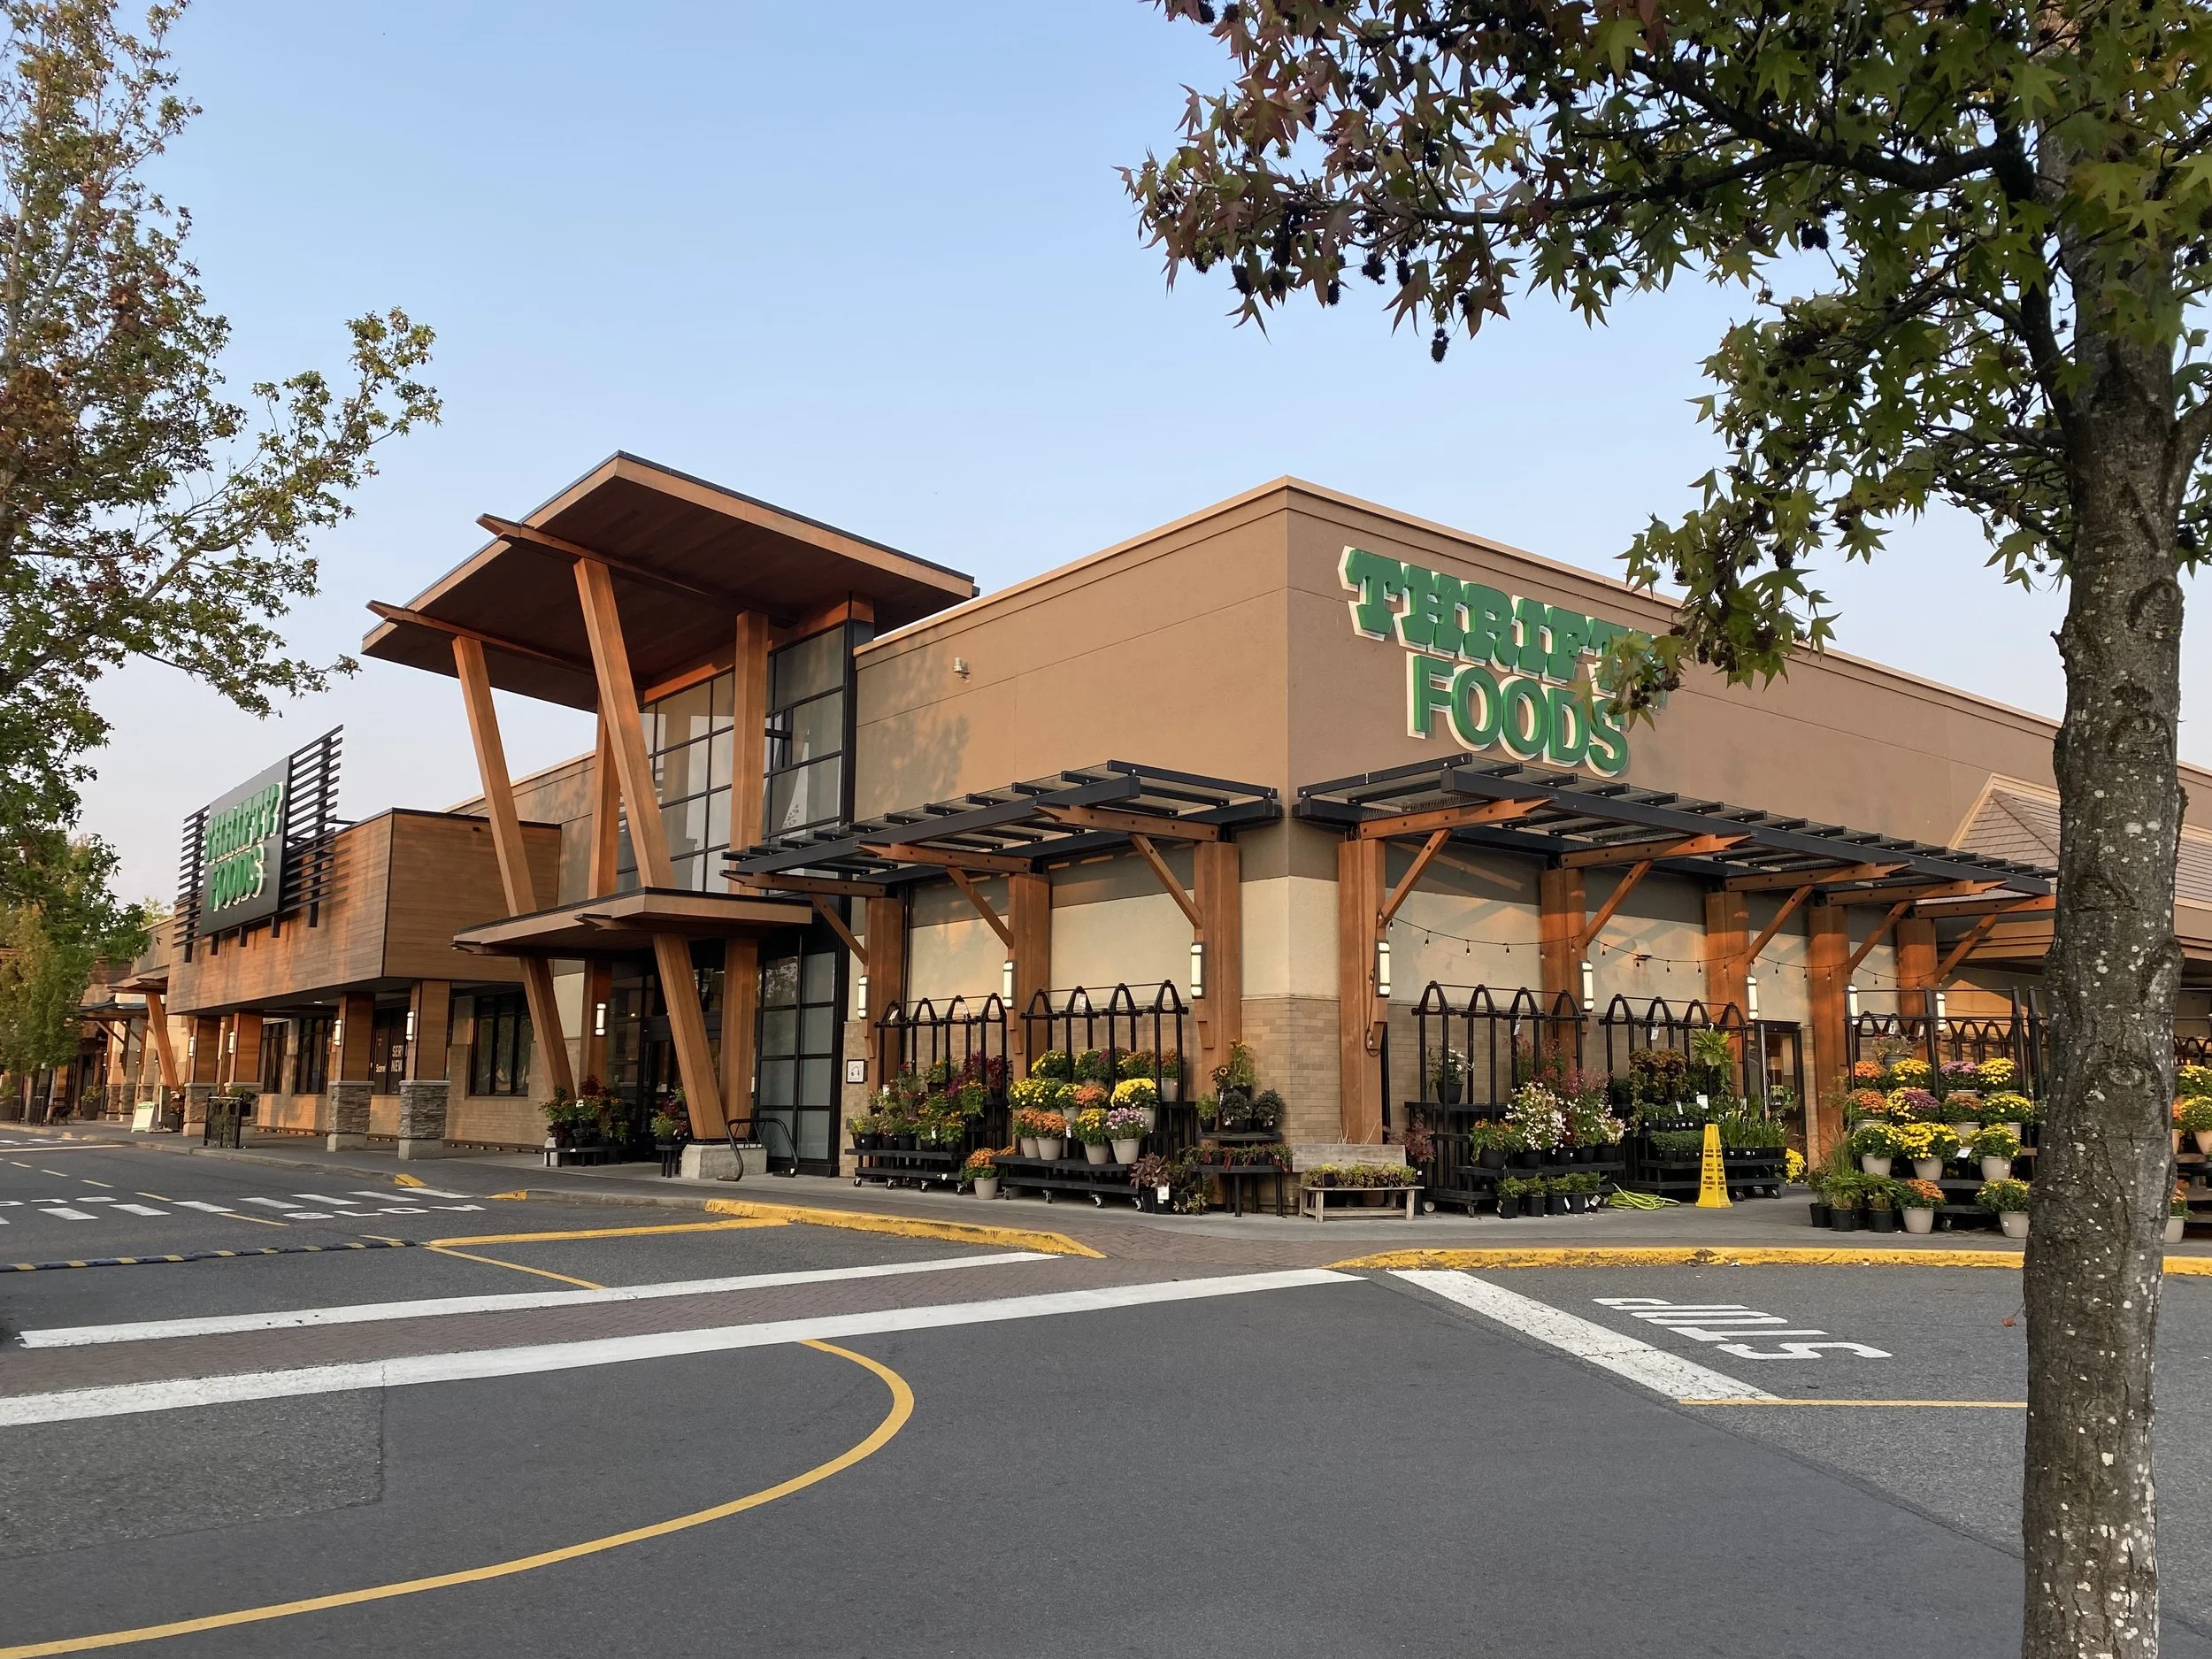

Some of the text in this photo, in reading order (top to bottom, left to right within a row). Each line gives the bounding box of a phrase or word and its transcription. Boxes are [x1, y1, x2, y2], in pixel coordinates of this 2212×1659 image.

[1338, 545, 1667, 709] THRIFT
[1406, 651, 1630, 778] FOODS
[204, 781, 283, 865] THRIFTY
[209, 842, 265, 912] FOODS
[282, 1204, 487, 1219] SLOW
[1593, 1297, 1893, 1360] STOP
